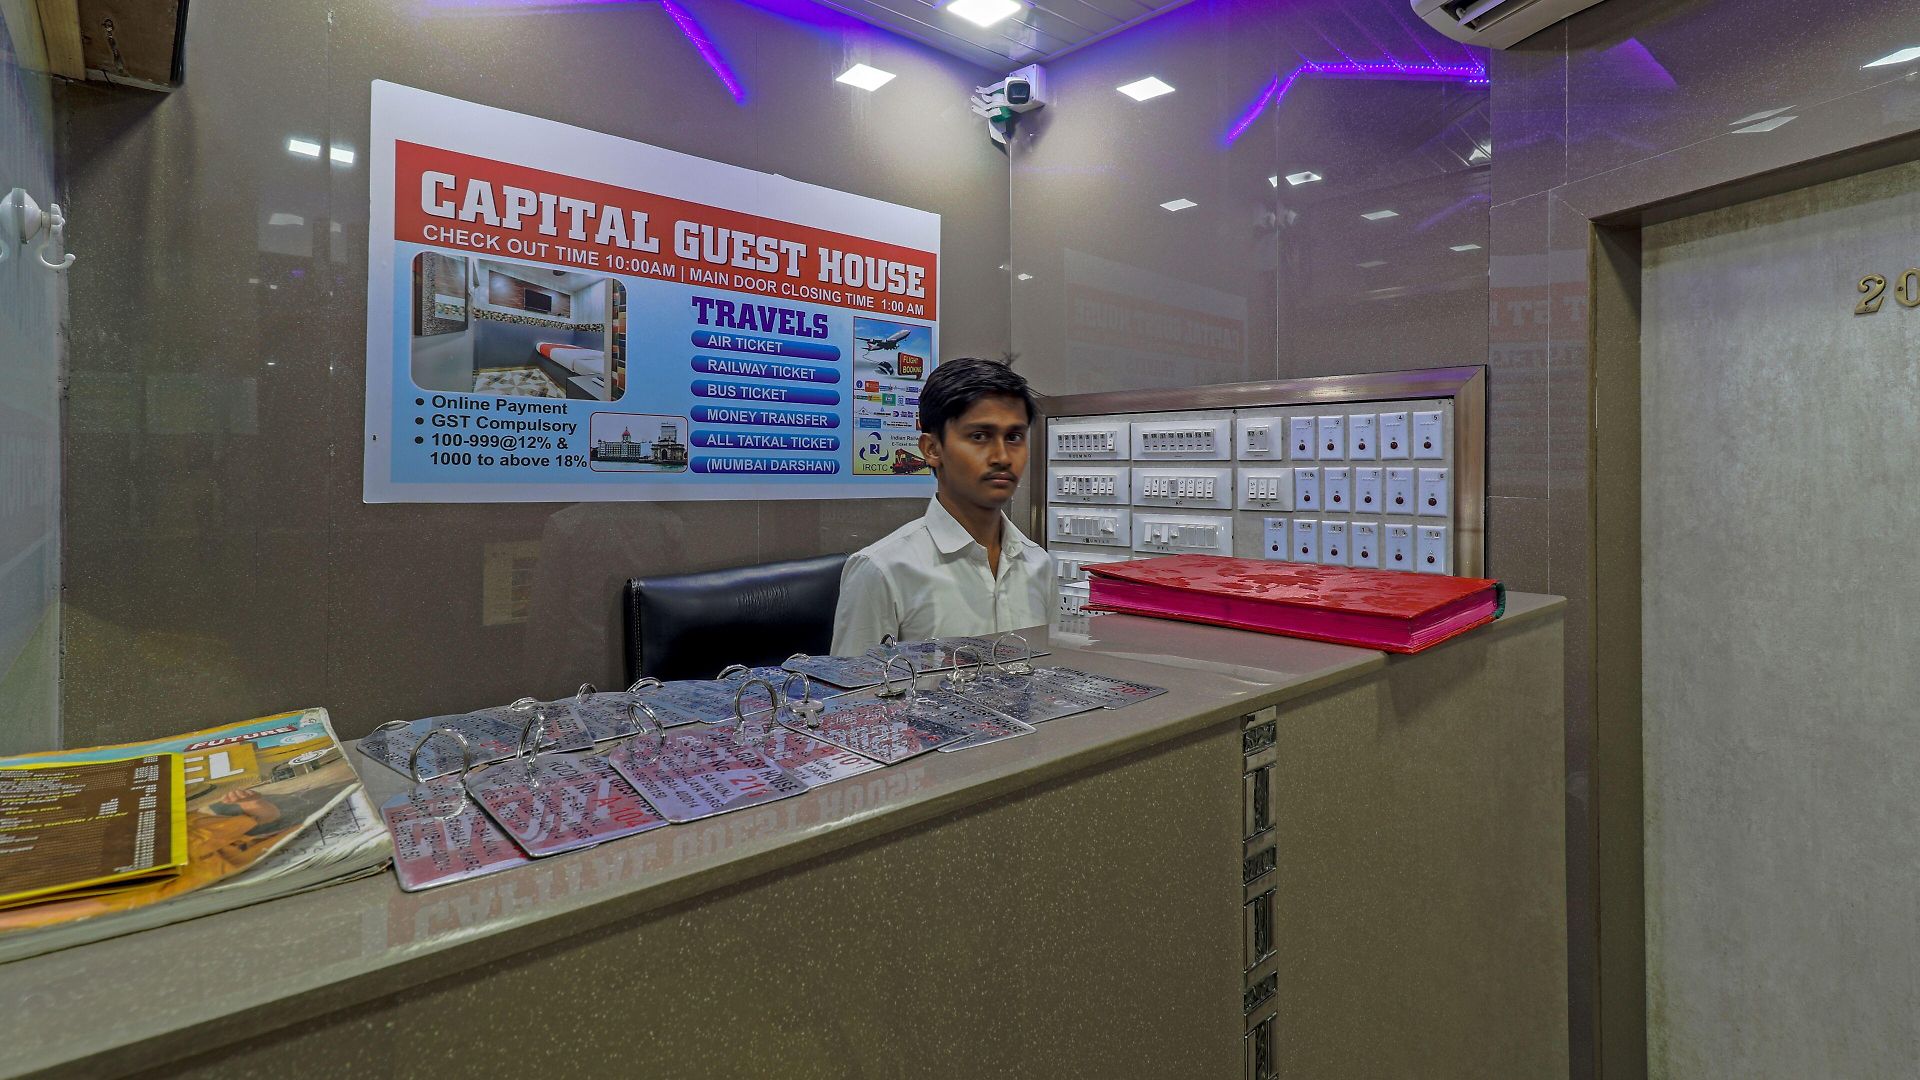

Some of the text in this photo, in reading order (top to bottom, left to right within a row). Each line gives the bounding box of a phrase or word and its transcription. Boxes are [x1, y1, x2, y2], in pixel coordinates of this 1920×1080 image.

[421, 170, 925, 299] CAPITAL GUEST HOUSE
[423, 224, 501, 251] CHECK
[507, 238, 549, 258] OUT
[555, 245, 599, 266] TIME
[605, 254, 676, 278] 10:00AM
[689, 267, 729, 286] MAIN
[734, 275, 777, 294] DOOR
[781, 283, 842, 303] CLOSING
[845, 293, 874, 309] TIME
[881, 298, 904, 314] 1:00
[906, 302, 924, 316] AM
[691, 296, 829, 340] TRAVELS
[707, 334, 784, 353] AIR TICKET
[707, 359, 816, 380] RAILWAY TICKET
[707, 383, 788, 401] BUS TICKET
[431, 394, 568, 415] Online Payment
[431, 414, 577, 435] GST Compulsory
[707, 408, 829, 426] MONEY TRANSFER
[431, 433, 569, 451] 100-999@12% &
[706, 434, 834, 449] ALL TATKAL TICKET
[430, 451, 588, 468] 1000 to above 18%
[706, 458, 836, 474] (MUMBAI DARSHAN)
[862, 463, 888, 472] IRCTC
[190, 725, 295, 750] FUTURE
[757, 769, 800, 793] HOUSE
